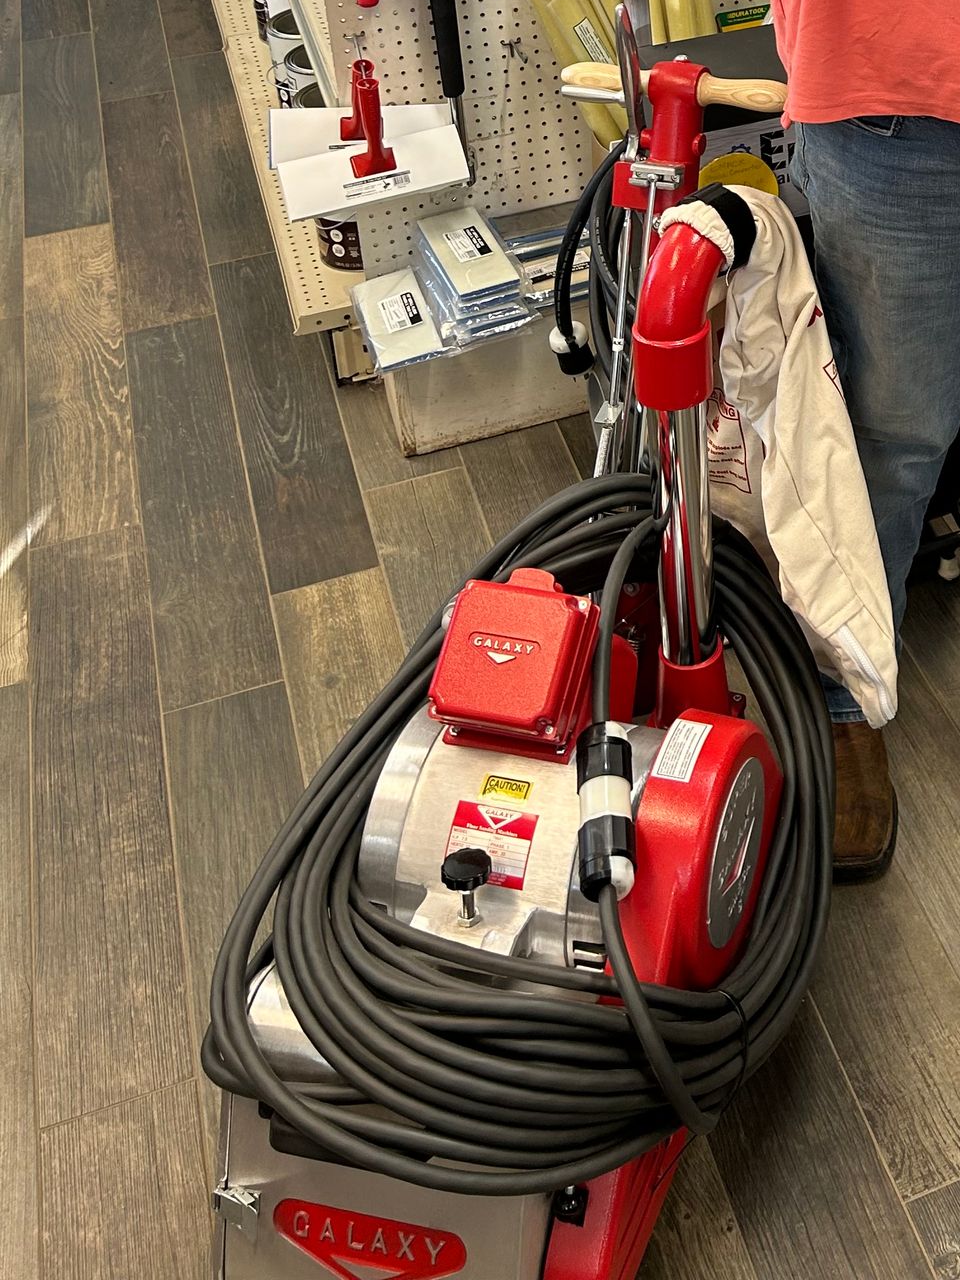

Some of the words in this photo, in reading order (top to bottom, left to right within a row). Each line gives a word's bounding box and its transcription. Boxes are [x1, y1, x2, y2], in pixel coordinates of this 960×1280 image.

[473, 635, 535, 654] GALAXY
[489, 778, 526, 793] CAUTION!
[486, 809, 514, 819] GALAXY
[293, 1210, 448, 1265] GALAXY
